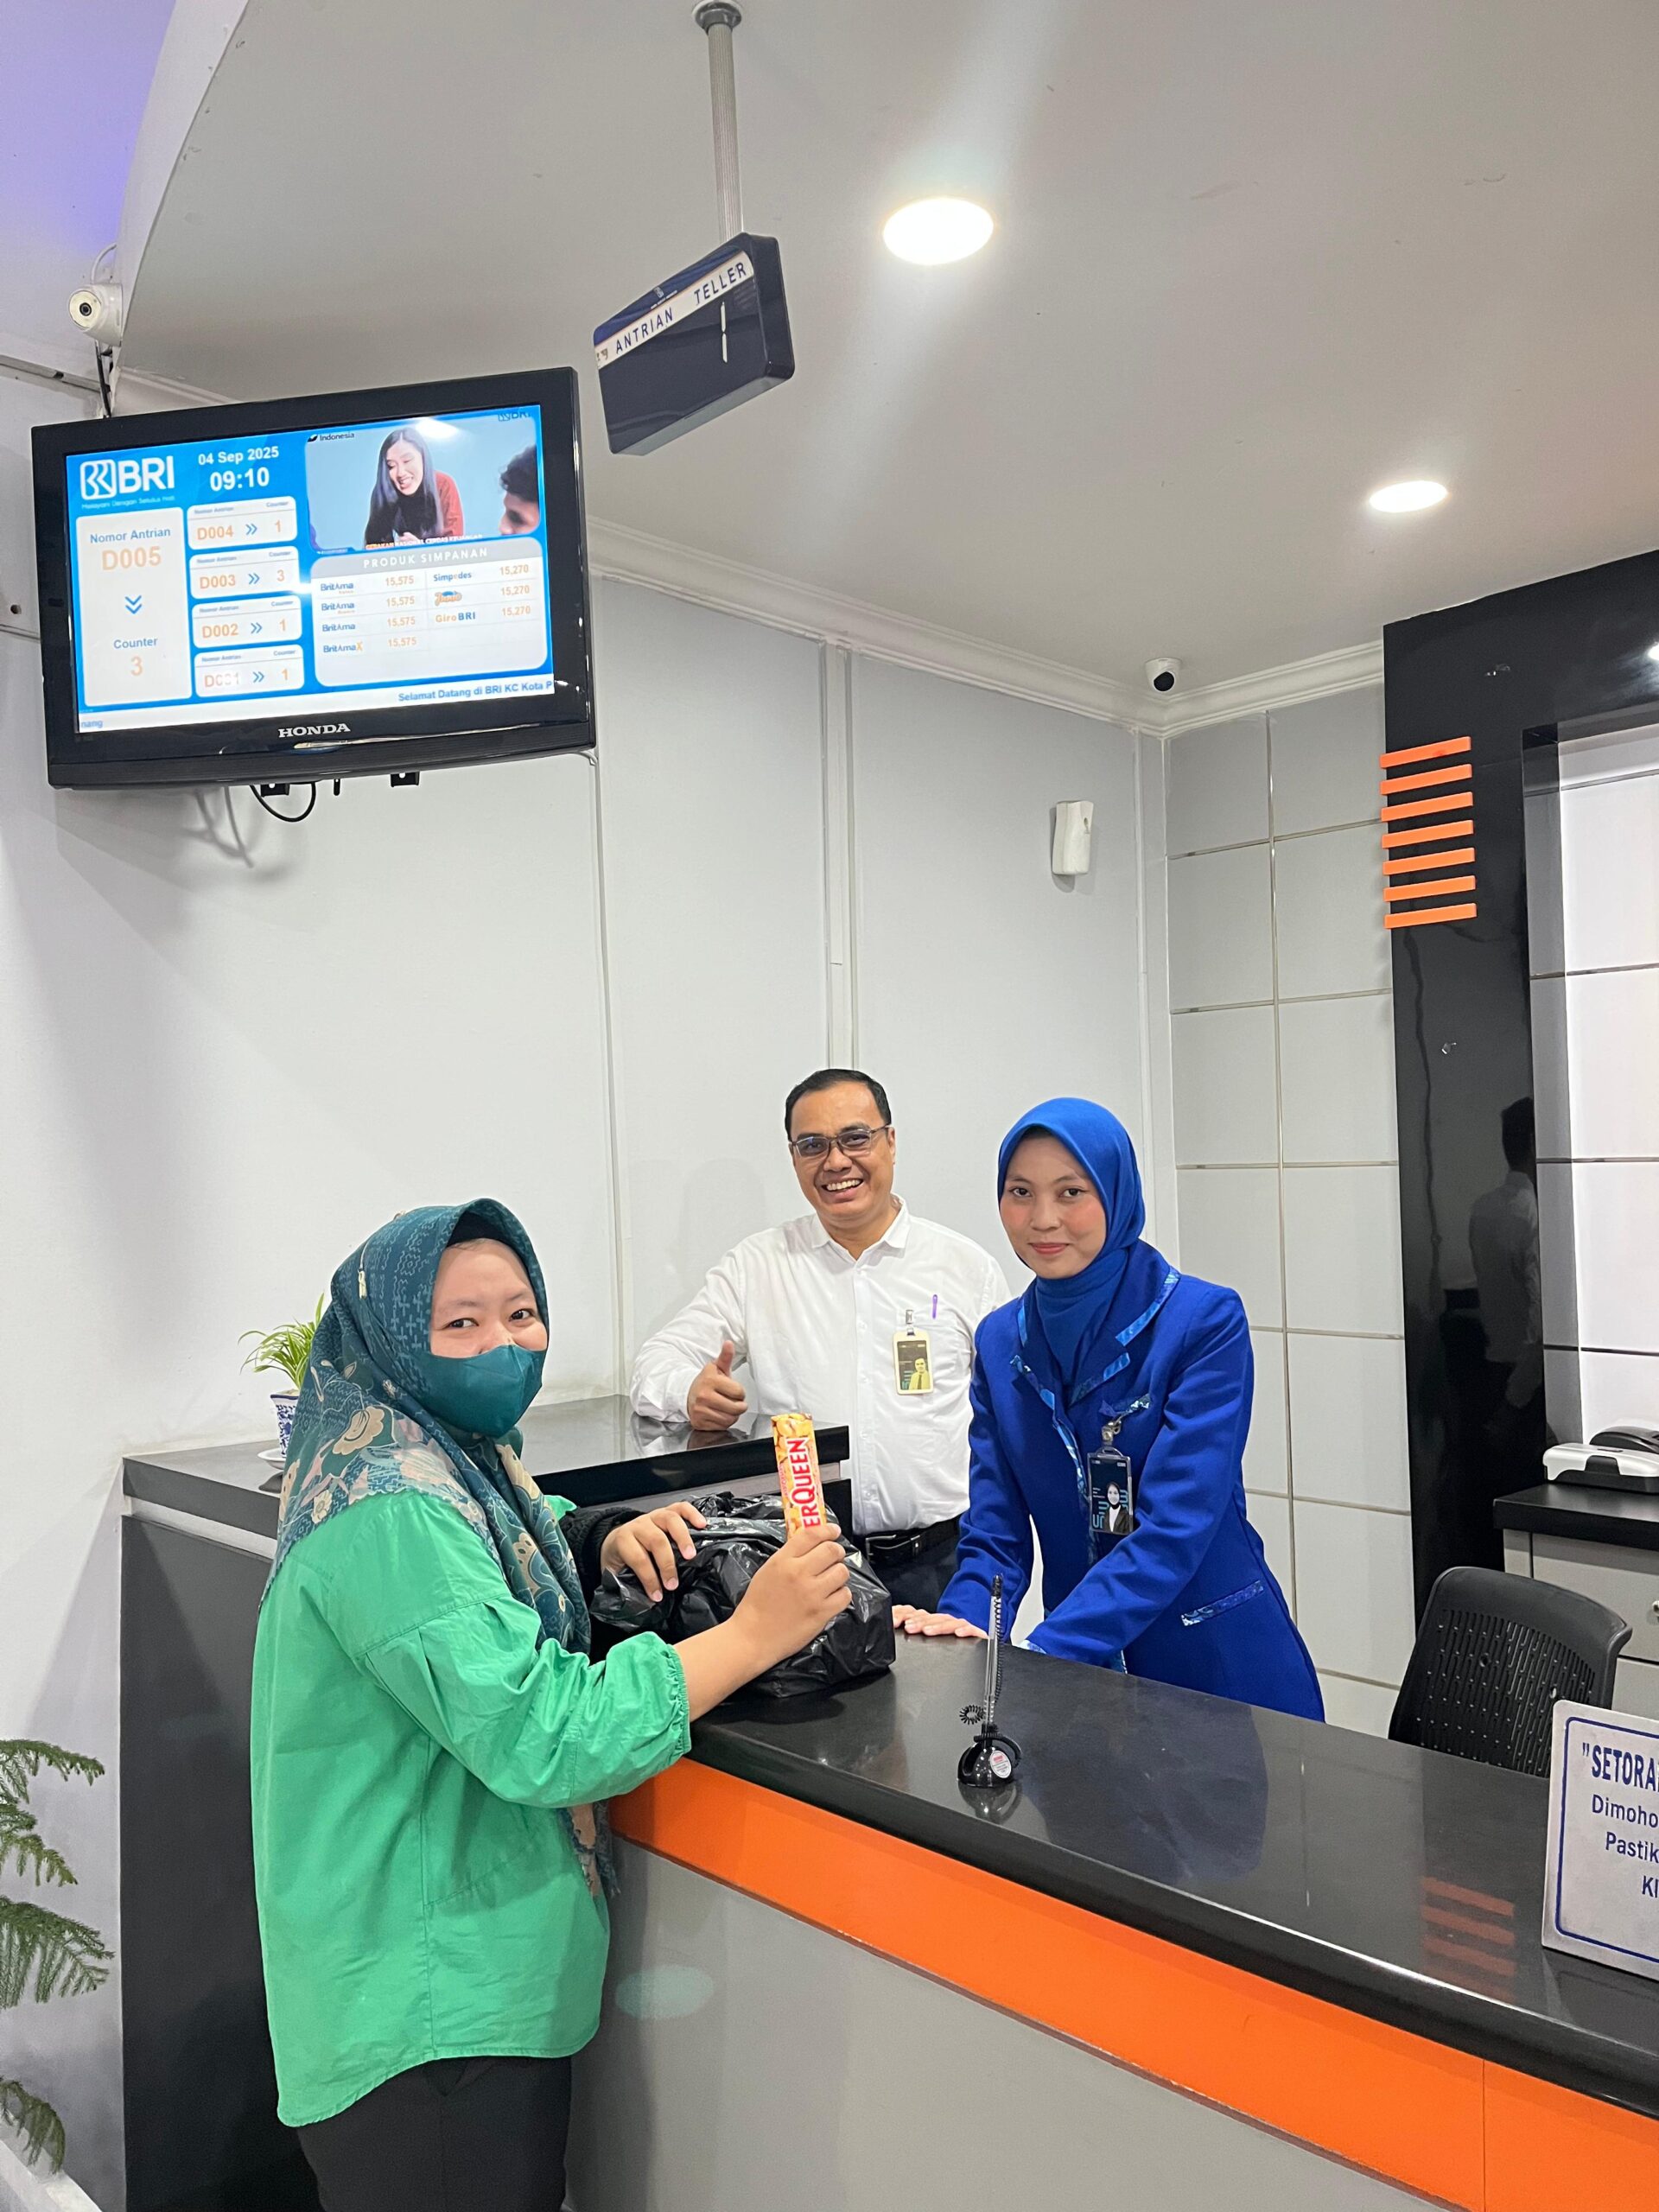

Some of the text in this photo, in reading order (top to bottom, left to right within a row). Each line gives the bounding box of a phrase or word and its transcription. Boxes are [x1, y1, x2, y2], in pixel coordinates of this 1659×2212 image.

[615, 307, 674, 355] ANTRIAN
[694, 261, 747, 307] TELLER
[319, 432, 355, 442] Indonesia
[198, 446, 279, 466] 04 Sep 2025
[118, 455, 175, 494] BRI
[210, 467, 270, 492] 09:10
[90, 527, 171, 543] Nomor Antrian
[197, 519, 282, 541] D004 1
[101, 545, 162, 571] D005
[363, 547, 488, 569] PRODUK SIMPANAN
[200, 569, 285, 589] D003 3
[433, 564, 530, 582] Simpedes 15,270
[321, 582, 354, 592] BritAma
[385, 575, 415, 587] 15,575
[501, 585, 531, 596] 15,270
[321, 602, 355, 612] BritAma
[386, 595, 415, 607] 15,575
[502, 605, 531, 617] 15,270
[201, 618, 287, 639] D002 1
[321, 616, 416, 632] BritAma 15,575
[113, 638, 158, 649] Counter
[388, 636, 417, 648] 15,575
[130, 655, 143, 677] 3
[281, 668, 289, 681] 1
[398, 691, 436, 702] Selamat
[438, 688, 472, 698] Datang
[485, 685, 502, 695] BRI
[505, 683, 518, 693] KC
[521, 683, 543, 691] Kota
[545, 680, 552, 690] P
[277, 722, 352, 739] HONDA
[1582, 1741, 1659, 1793] "SETORA
[1605, 1831, 1659, 1864] Pastik
